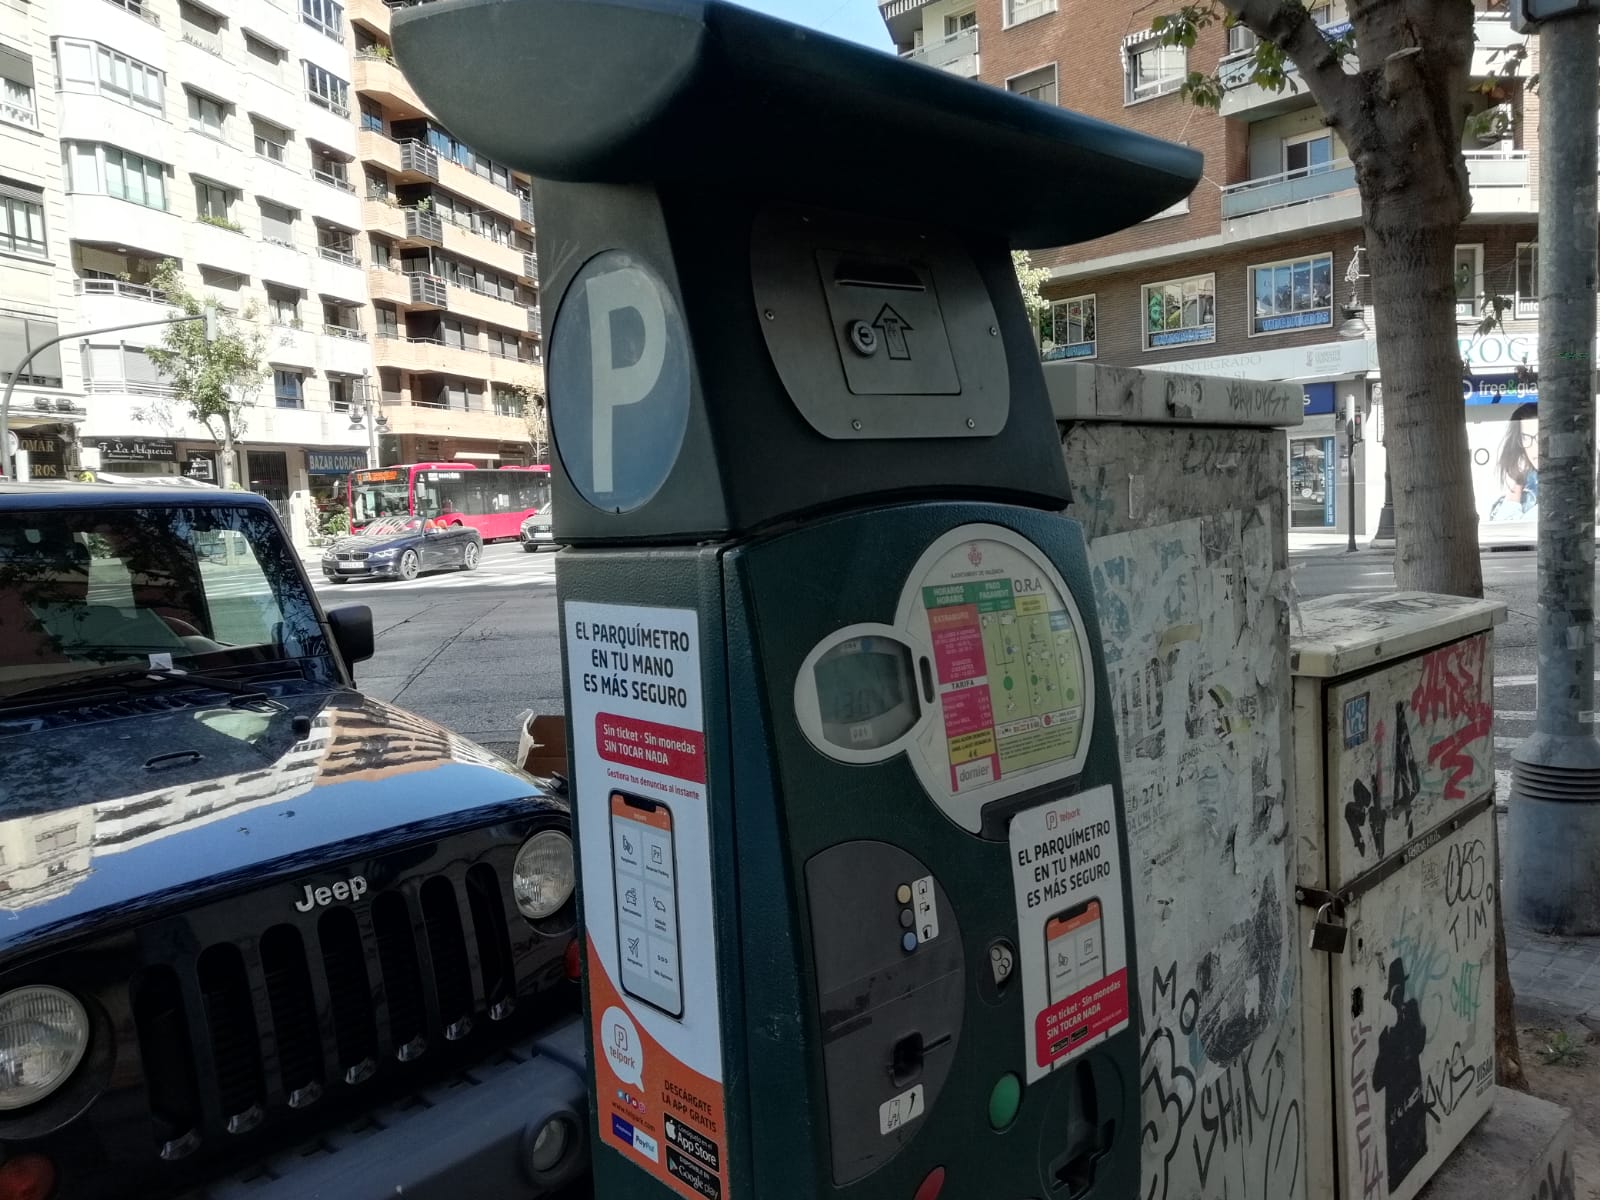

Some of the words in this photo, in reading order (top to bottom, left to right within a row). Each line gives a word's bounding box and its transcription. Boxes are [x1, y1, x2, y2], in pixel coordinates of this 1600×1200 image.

[585, 268, 666, 493] P
[309, 455, 333, 470] BAZAR
[576, 621, 589, 641] EL
[592, 622, 690, 652] PARQUÍMETRO
[591, 648, 608, 669] EN
[610, 651, 629, 671] TU
[633, 654, 674, 678] MANO
[583, 673, 598, 692] ES
[601, 673, 628, 698] MÁS
[632, 680, 687, 708] SEGURO
[952, 680, 975, 690] TARIFA
[603, 723, 615, 736] Sin
[616, 725, 638, 742] ticket
[644, 731, 657, 746] Sin
[658, 734, 696, 754] monedas
[604, 739, 617, 753] SIN
[618, 742, 644, 760] TOCAR
[645, 748, 669, 765] NADA
[607, 767, 630, 782] Gestiona
[630, 774, 639, 784] tus
[640, 776, 668, 792] denuncias
[669, 782, 674, 793] al
[675, 783, 700, 800] instante
[959, 765, 990, 782] dornier
[1018, 848, 1032, 866] EL
[1034, 819, 1111, 861] PARQUÍMETRO
[1034, 863, 1049, 882] EN
[1052, 857, 1067, 875] TU
[1069, 844, 1101, 869] MANO
[295, 875, 367, 912] Jeep
[1027, 889, 1040, 908] ES
[1043, 877, 1067, 902] MÁS
[1070, 861, 1111, 891] SEGURO
[1046, 1014, 1057, 1027] Sin
[1058, 1002, 1078, 1021] ticket
[1081, 996, 1093, 1007] Sin
[1093, 980, 1121, 1001] monedas
[1046, 1026, 1059, 1040] SIN
[1059, 1013, 1082, 1033] TOCAR
[1082, 1002, 1101, 1021] NADA
[609, 1045, 636, 1069] telpark
[661, 1092, 671, 1106] LA
[672, 1100, 688, 1113] APP
[689, 1108, 717, 1133] GRATIS
[664, 1079, 712, 1116] DESCÁRGATE
[677, 1132, 694, 1153] App
[694, 1142, 717, 1167] Store
[678, 1165, 704, 1190] Google
